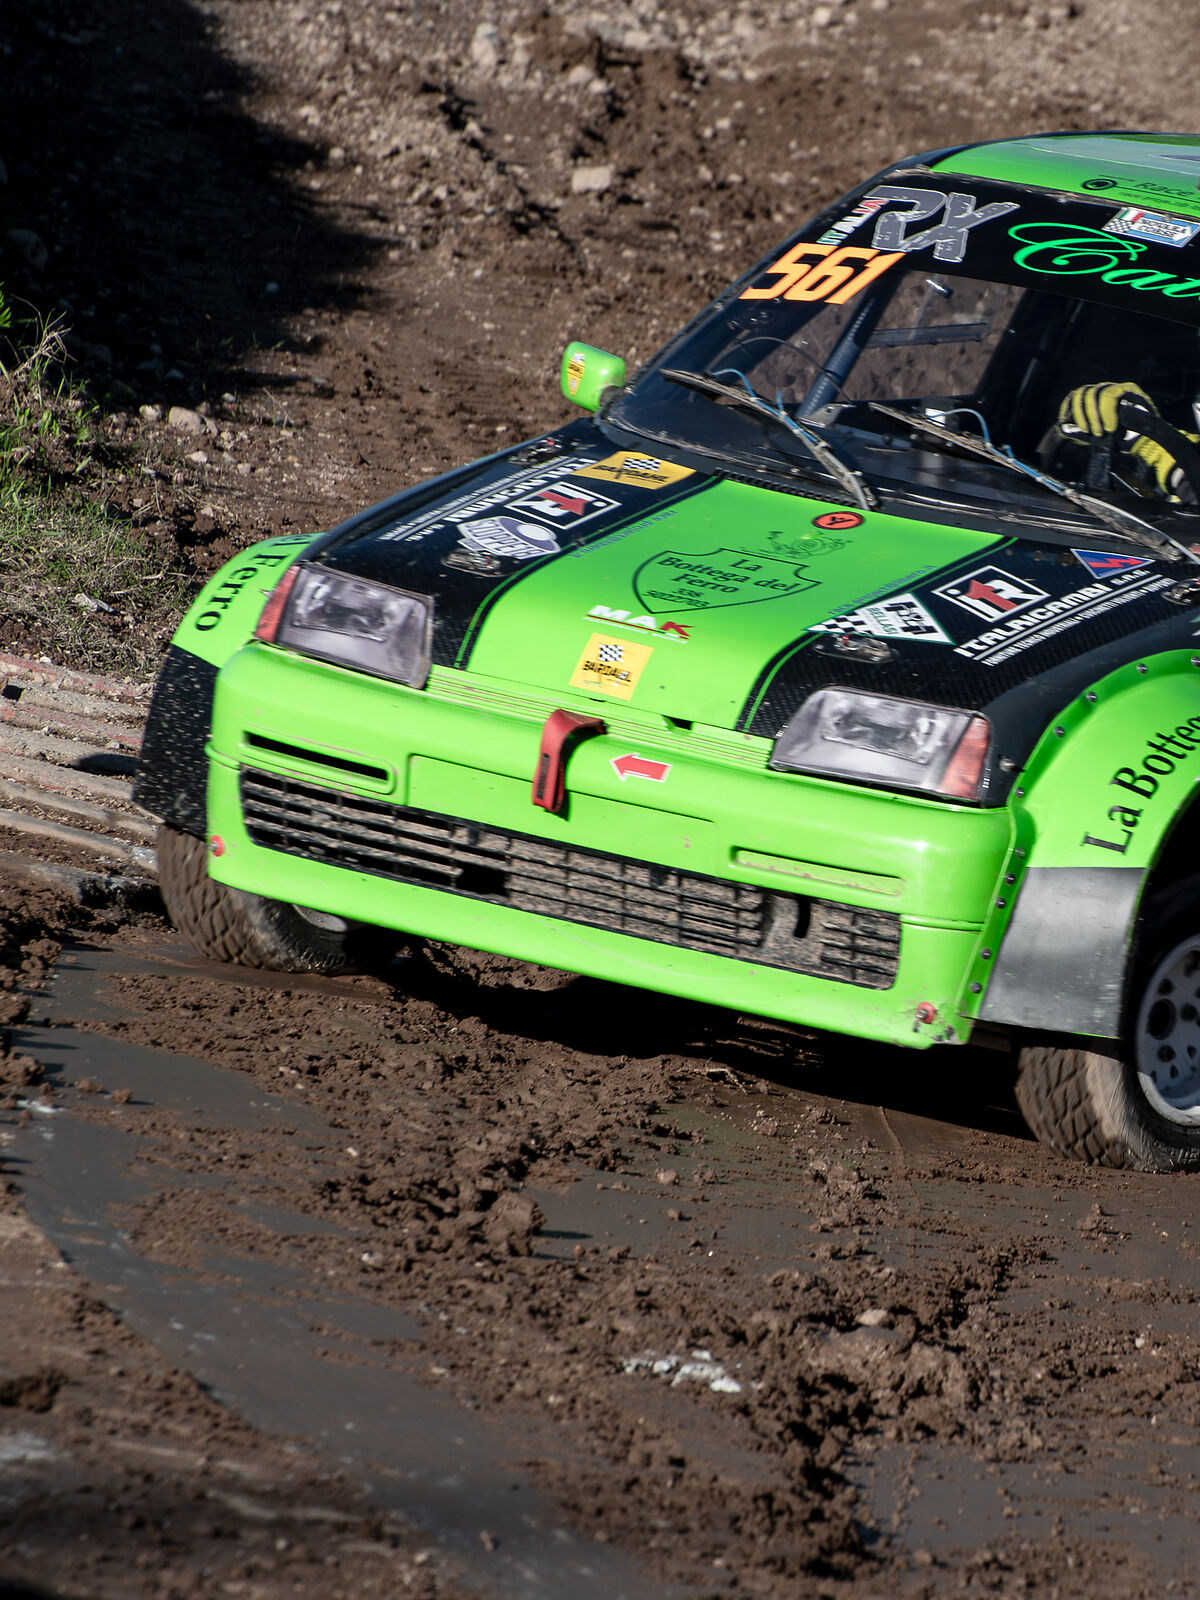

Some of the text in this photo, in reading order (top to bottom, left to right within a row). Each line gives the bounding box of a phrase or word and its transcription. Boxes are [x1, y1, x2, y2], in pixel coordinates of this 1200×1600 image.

[1135, 181, 1194, 197] Race
[816, 199, 890, 245] ITALIA
[862, 184, 1020, 263] RX
[738, 243, 906, 305] 561
[658, 556, 801, 592] Bottega del
[672, 573, 740, 594] Ferro
[728, 559, 763, 572] La
[196, 554, 291, 631] Ferro
[588, 605, 695, 637] MAK
[867, 607, 900, 634] BELLASI
[1081, 804, 1144, 856] La
